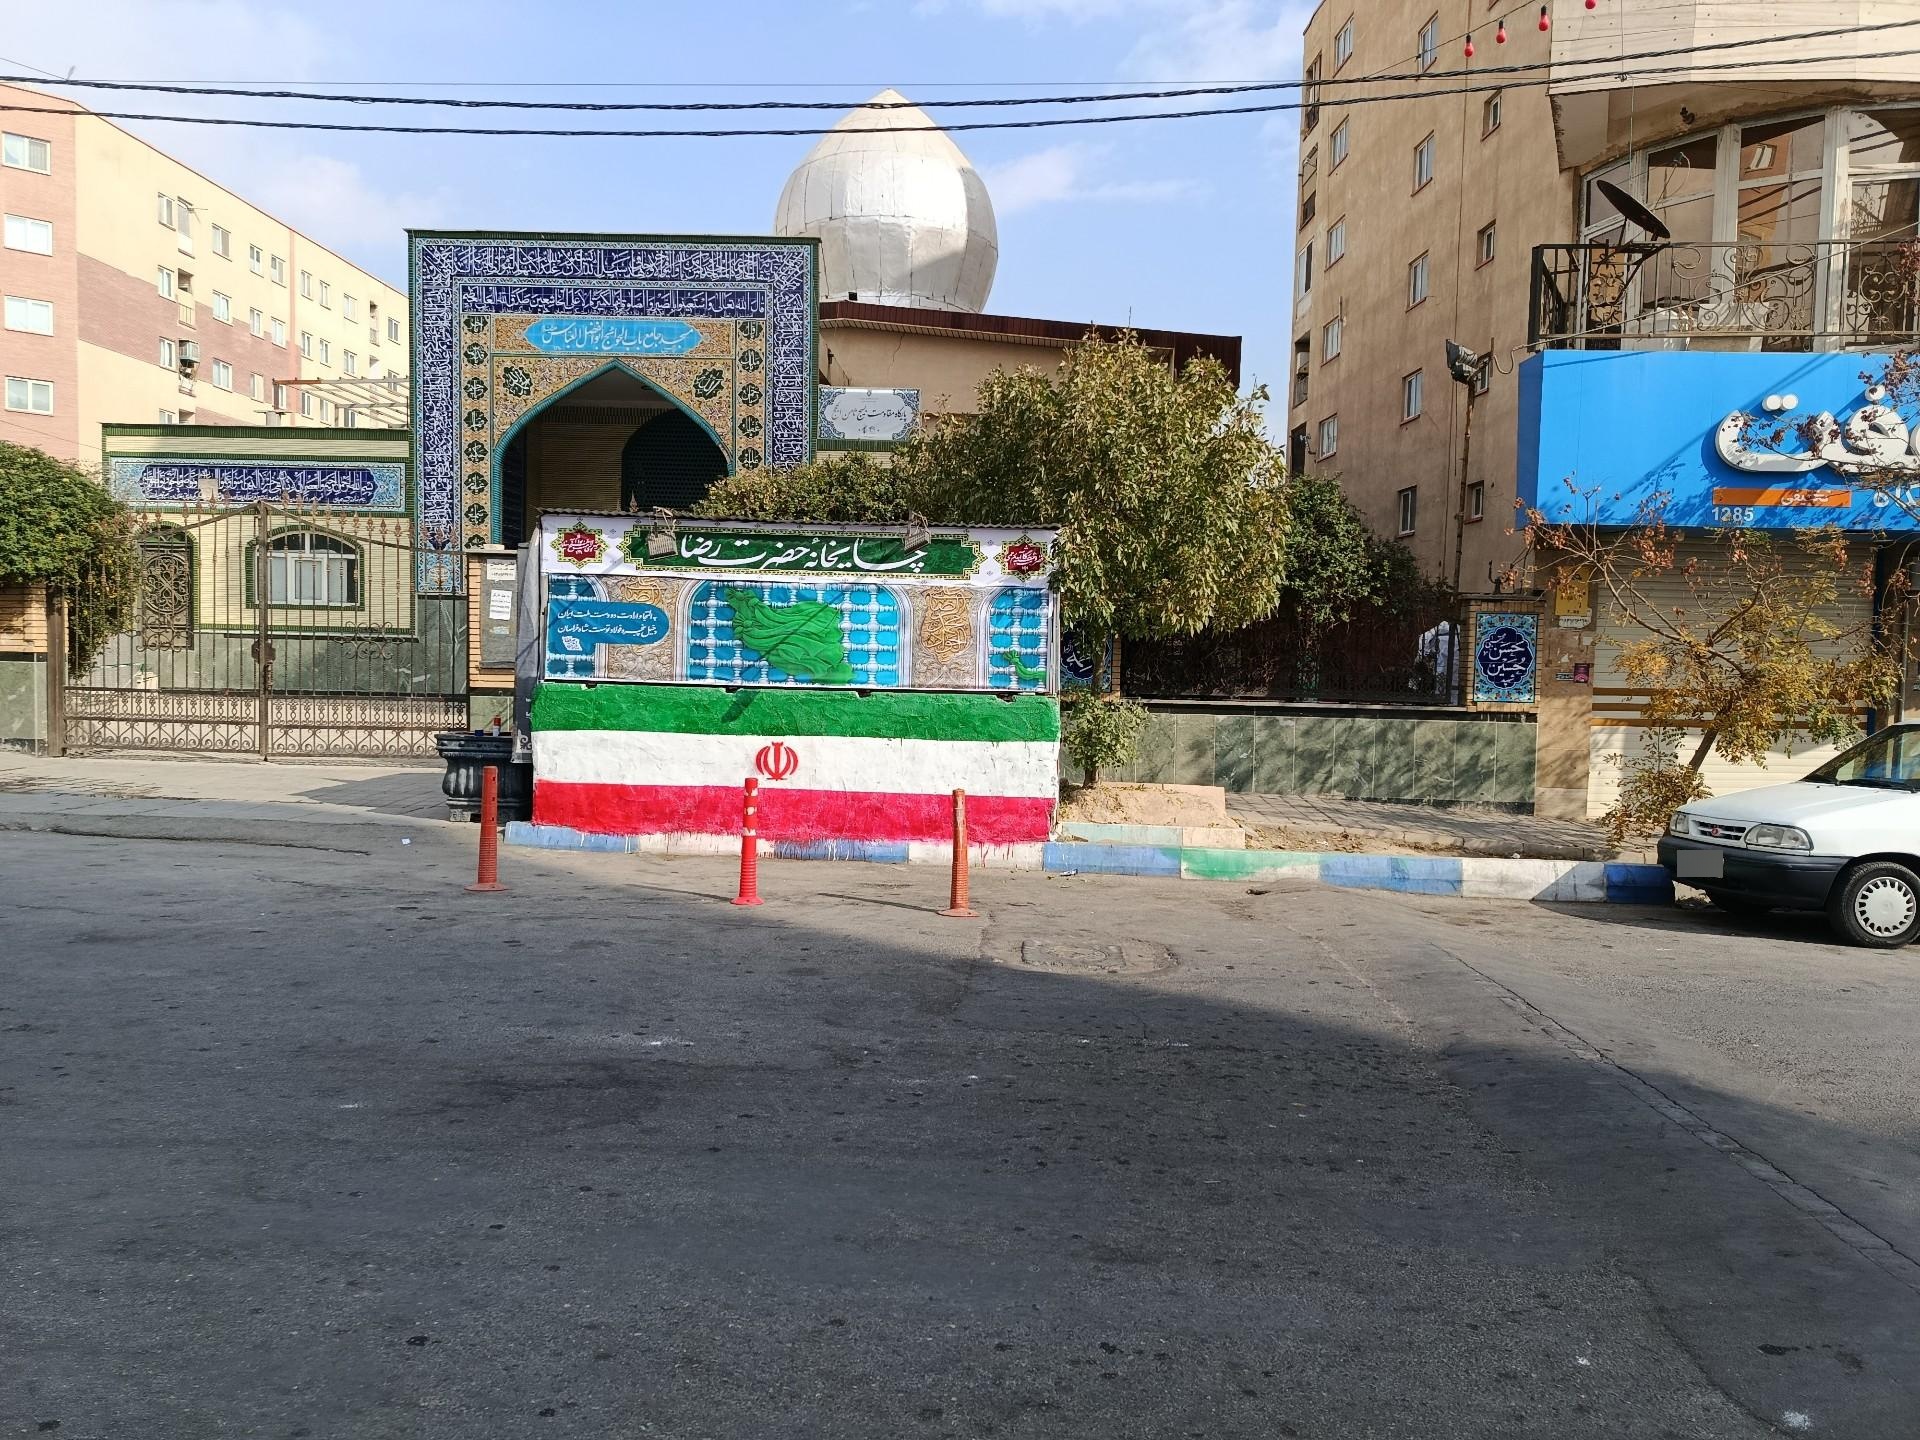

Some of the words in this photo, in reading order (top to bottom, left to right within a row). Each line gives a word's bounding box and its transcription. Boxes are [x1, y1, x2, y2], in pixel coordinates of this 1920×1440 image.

[622, 329, 643, 351] باب
[643, 326, 661, 348] جامع
[659, 328, 694, 349] مسجد
[867, 409, 895, 418] مقاومت
[894, 406, 907, 422] پایگاه
[1715, 384, 1920, 473] فت
[1711, 507, 1754, 522] 1285
[680, 533, 722, 559] رضا
[698, 538, 811, 570] حضرت
[557, 610, 574, 619] ایران
[557, 623, 579, 634] خراسان
[578, 623, 589, 633] شاه
[1488, 640, 1526, 661] حسن
[1487, 658, 1527, 677] حسین
